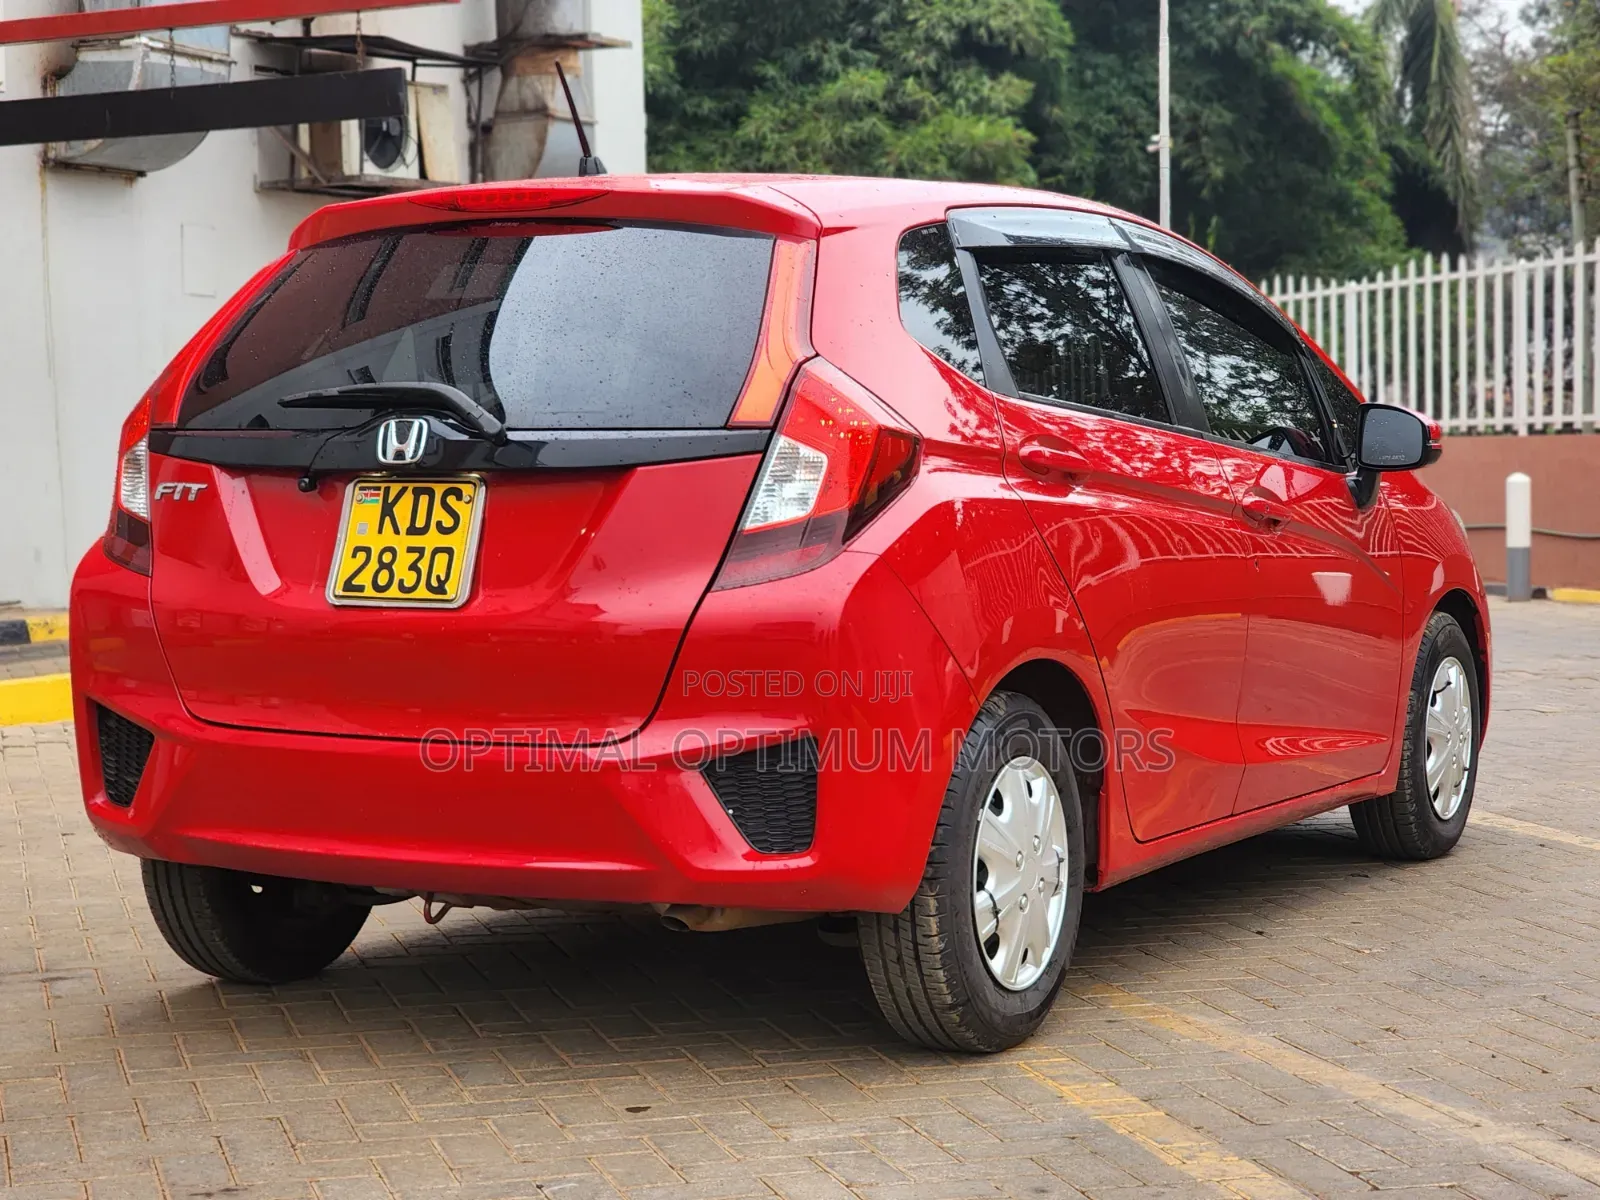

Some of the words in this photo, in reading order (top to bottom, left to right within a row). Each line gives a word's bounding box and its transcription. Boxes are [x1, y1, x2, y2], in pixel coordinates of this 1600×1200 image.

[154, 482, 208, 501] FIT
[377, 486, 464, 536] KDS
[342, 546, 455, 595] 283Q
